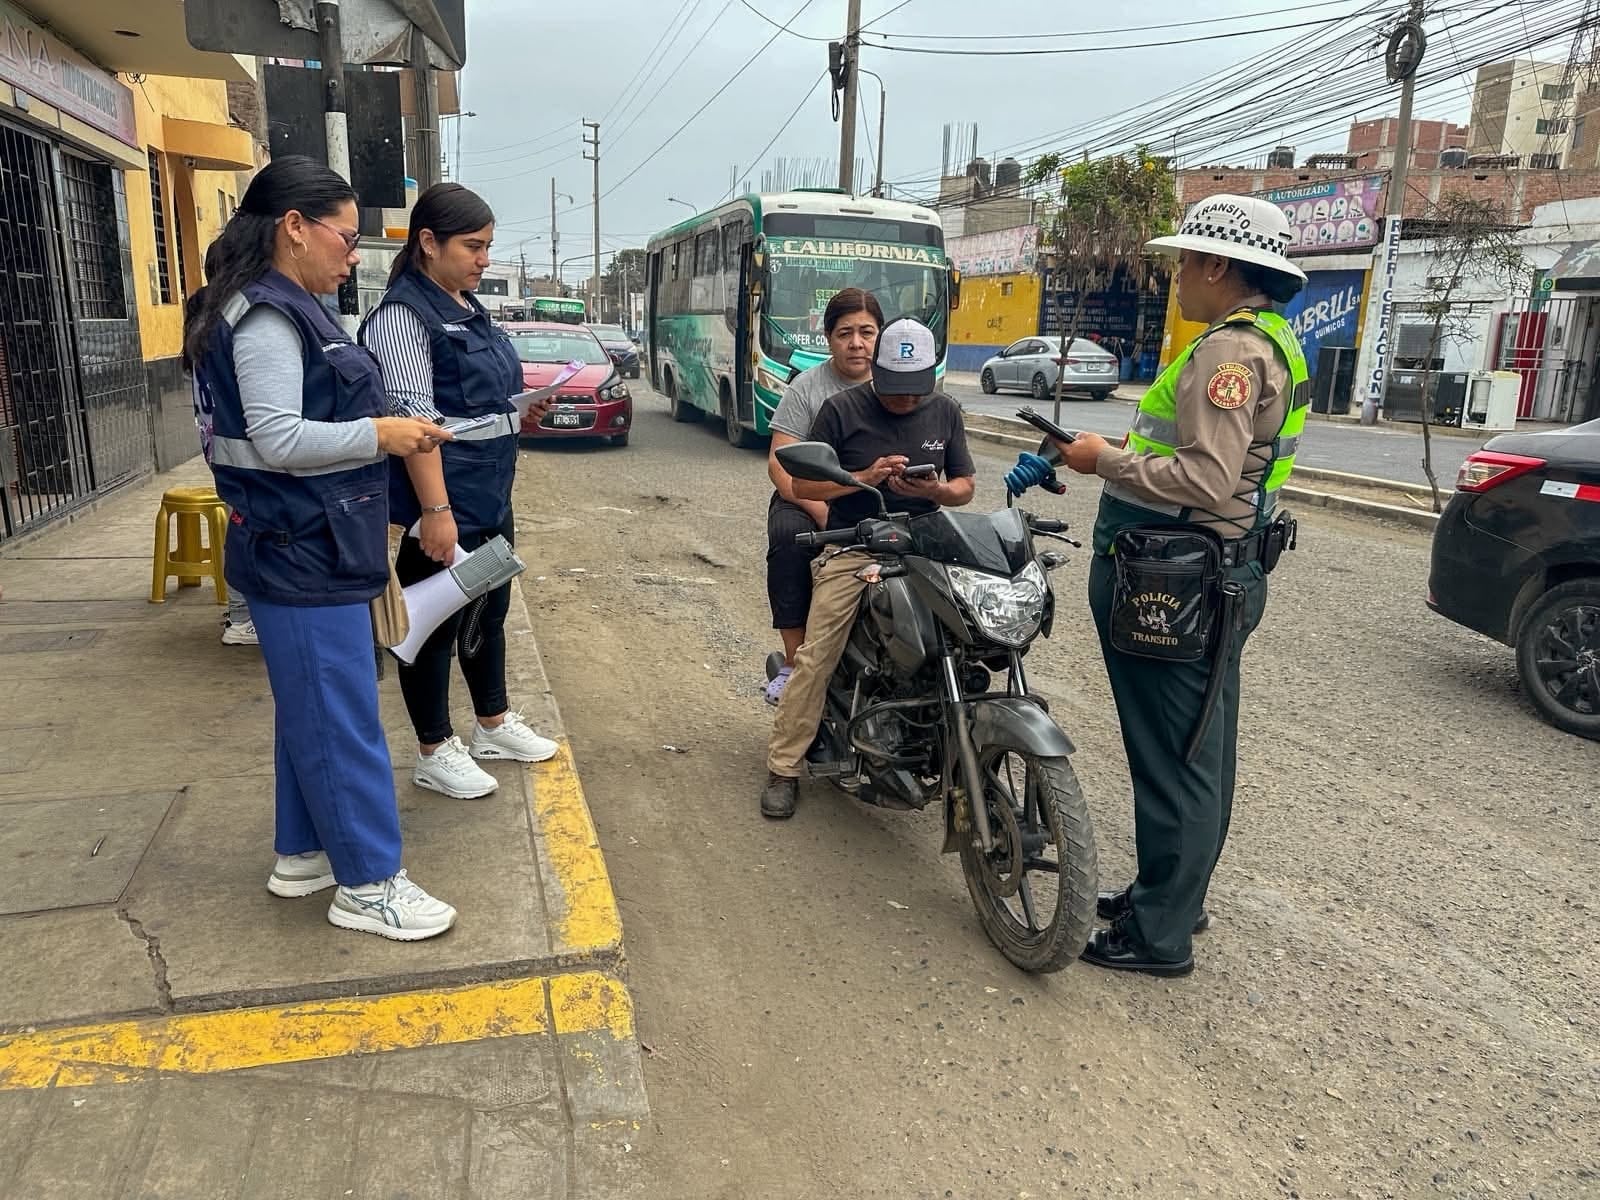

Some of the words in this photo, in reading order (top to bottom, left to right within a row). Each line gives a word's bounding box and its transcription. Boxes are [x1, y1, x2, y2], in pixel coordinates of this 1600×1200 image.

[1275, 184, 1330, 200] AUTORIZADO
[1193, 203, 1251, 230] TRANSITO
[783, 239, 931, 263] CALIFORNIA
[1371, 219, 1401, 395] REFRIGERACION
[1315, 318, 1345, 339] QUIMICOS
[782, 333, 811, 345] CHOFER
[1131, 592, 1181, 611] POLICIA
[1131, 631, 1179, 646] TRANSITO
